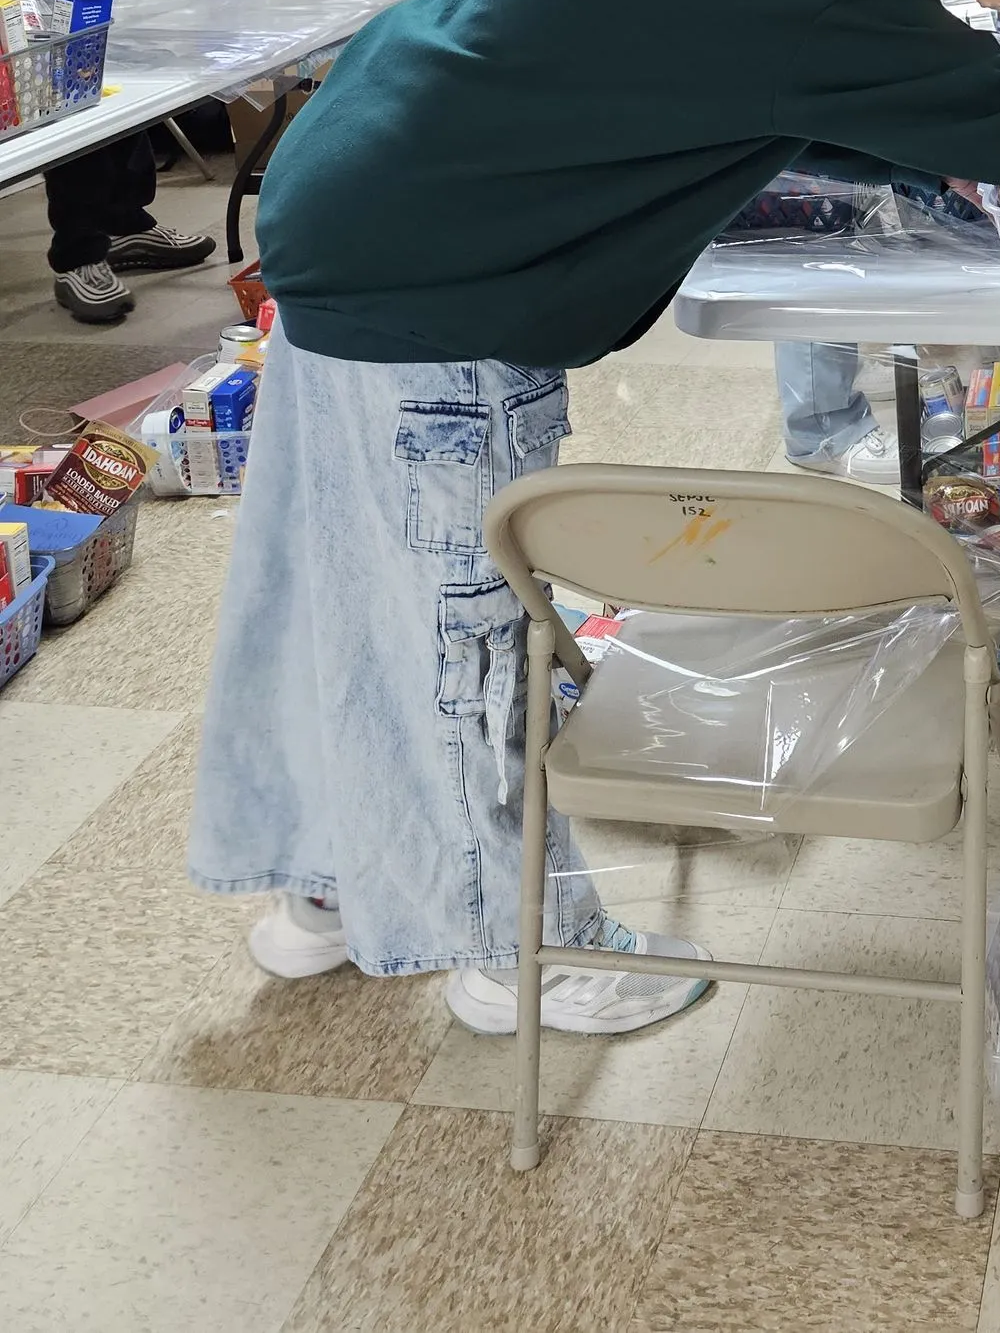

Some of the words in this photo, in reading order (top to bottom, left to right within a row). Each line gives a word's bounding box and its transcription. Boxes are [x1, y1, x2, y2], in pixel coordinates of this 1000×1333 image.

[82, 445, 138, 482] IDAHOAN
[66, 468, 95, 494] LOADED
[94, 488, 120, 509] BAKED
[682, 506, 711, 517] 152
